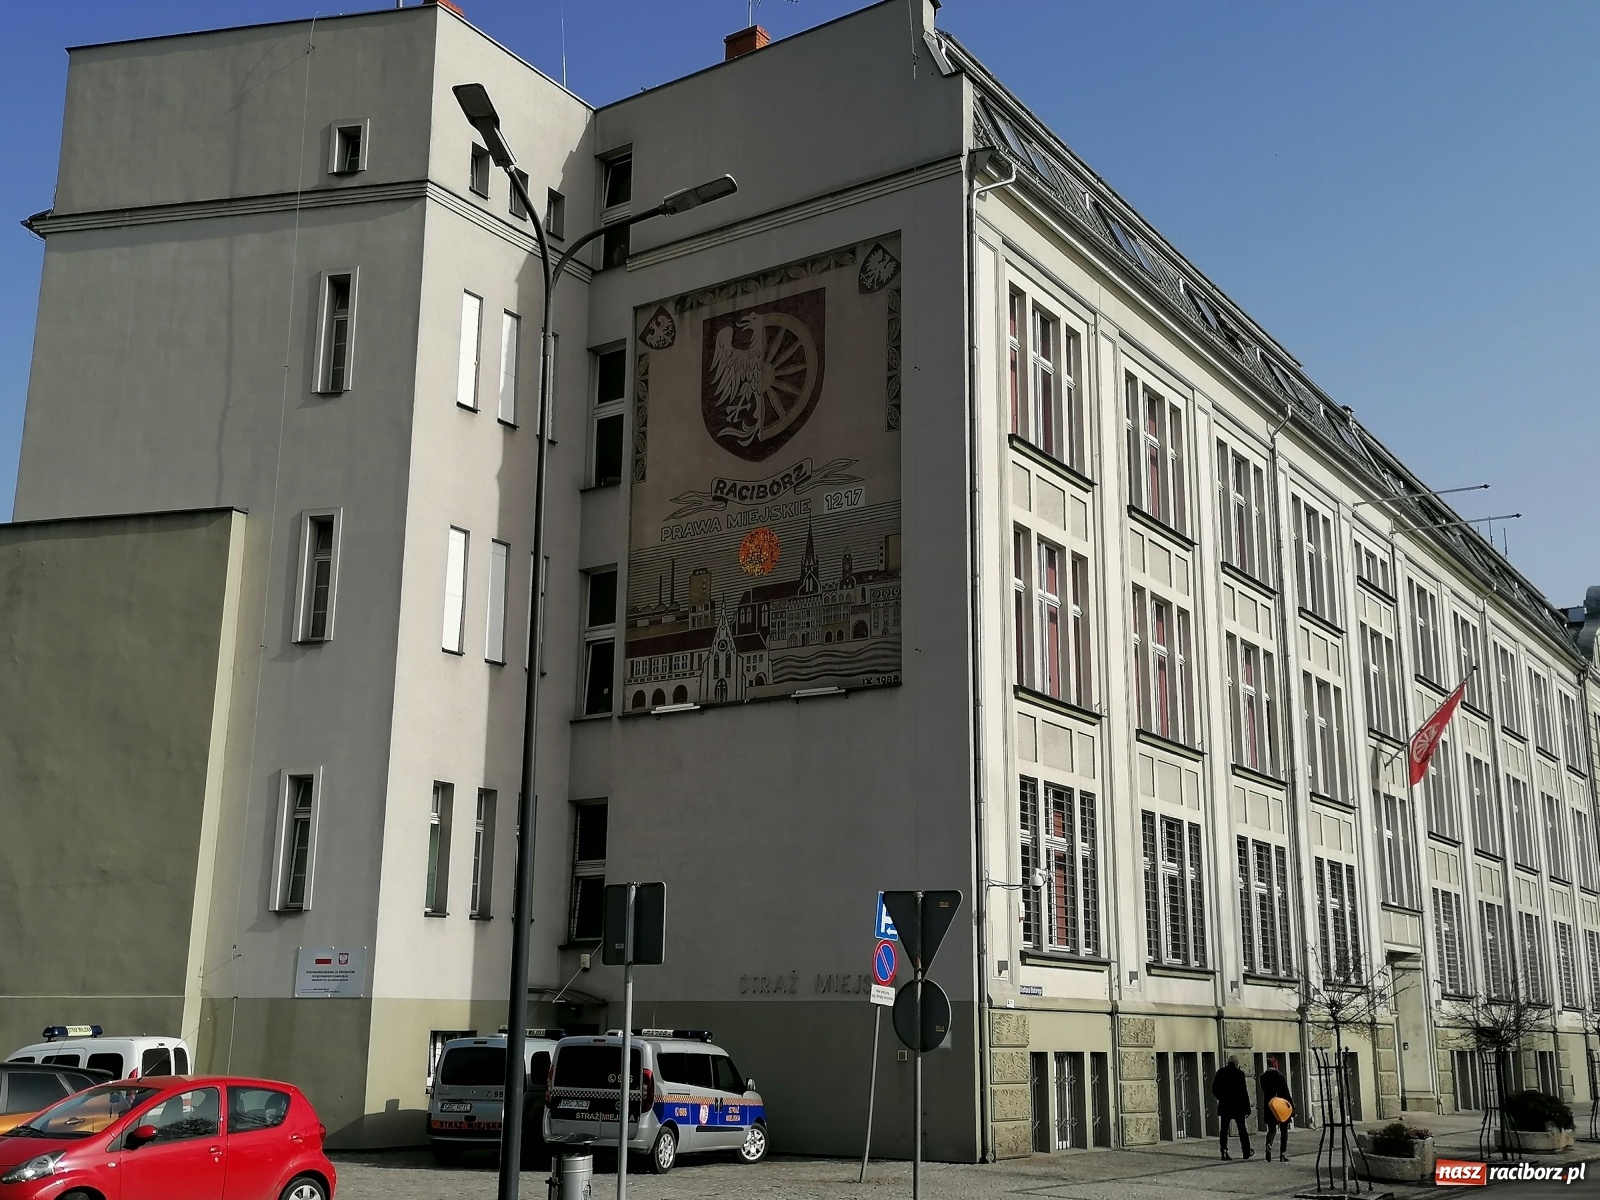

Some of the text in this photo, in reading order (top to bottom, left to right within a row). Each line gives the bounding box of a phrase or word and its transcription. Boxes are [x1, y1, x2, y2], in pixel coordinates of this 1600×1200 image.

[714, 463, 807, 500] RACIBÓRZ
[660, 488, 863, 542] PRAWA MIEJSKIE 1217
[739, 970, 872, 994] STRAŻ MIEJS
[575, 1112, 635, 1121] STRAŻ MIEJA
